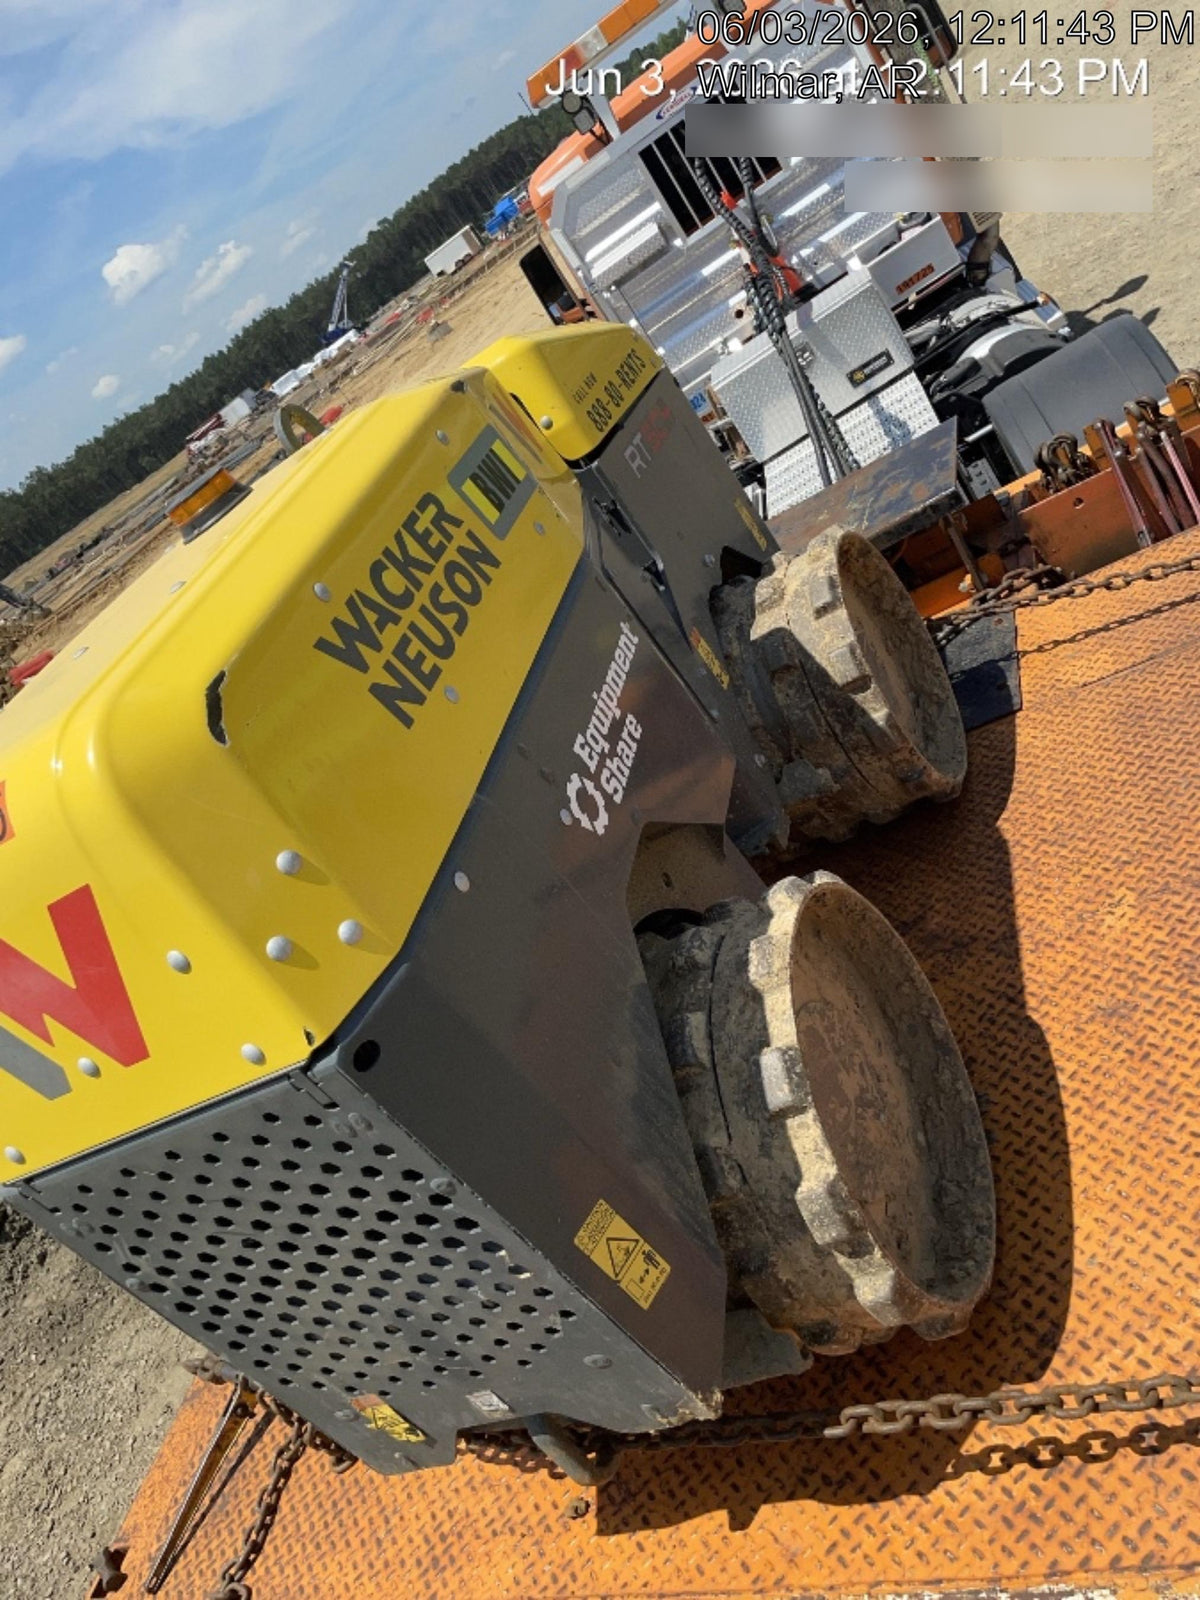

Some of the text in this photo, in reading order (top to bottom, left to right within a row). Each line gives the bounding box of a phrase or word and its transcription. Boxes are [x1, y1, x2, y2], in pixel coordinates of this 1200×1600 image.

[586, 347, 647, 433] 888-80-RENTS
[623, 431, 652, 479] RT
[313, 491, 465, 675] WACKER
[367, 528, 503, 730] NEUSON
[573, 620, 640, 774] Equipment
[600, 712, 644, 804] Share
